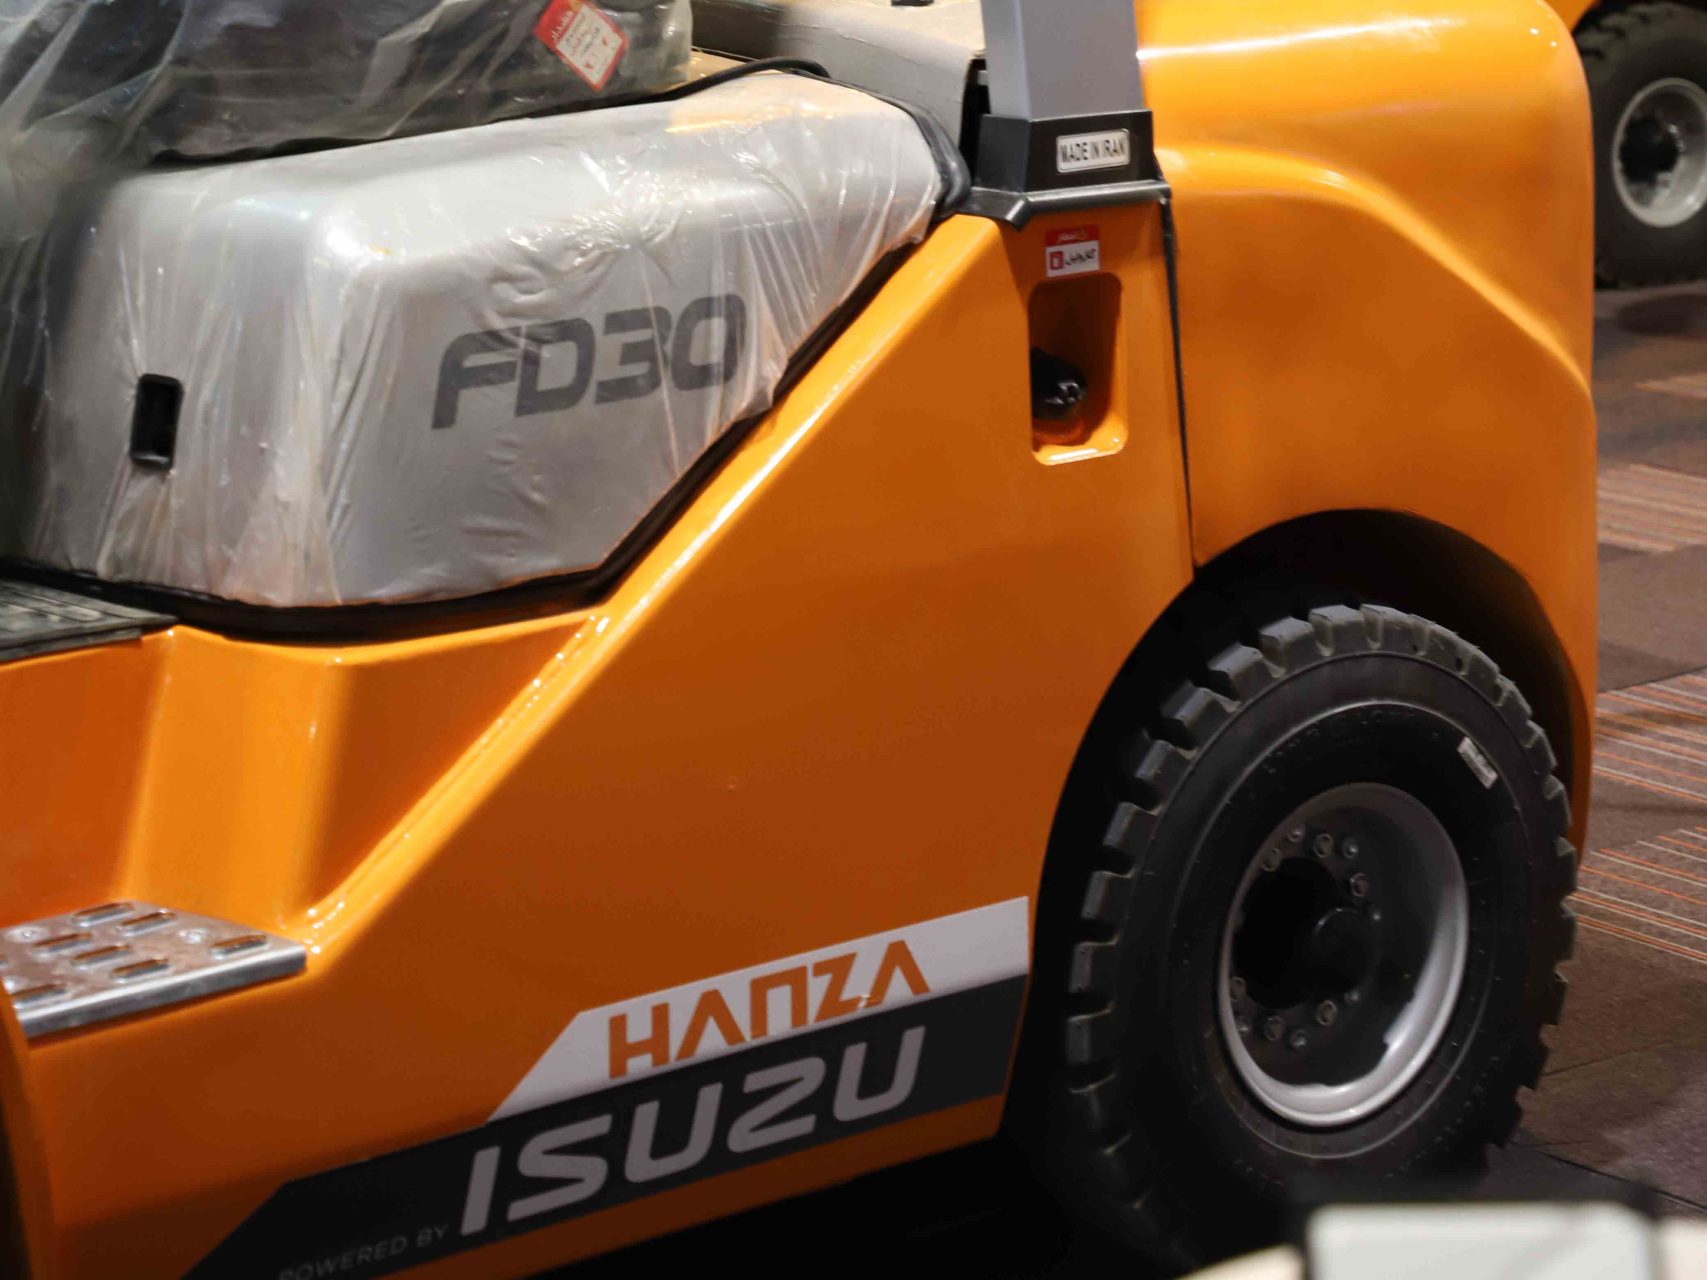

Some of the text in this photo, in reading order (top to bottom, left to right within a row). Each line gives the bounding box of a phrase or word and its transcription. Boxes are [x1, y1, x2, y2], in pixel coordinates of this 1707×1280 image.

[1060, 138, 1127, 163] MADE IN IRAN
[431, 294, 747, 430] FD30
[608, 940, 931, 1080] HANZA
[278, 1025, 926, 1280] POWERED BY ISUZU
